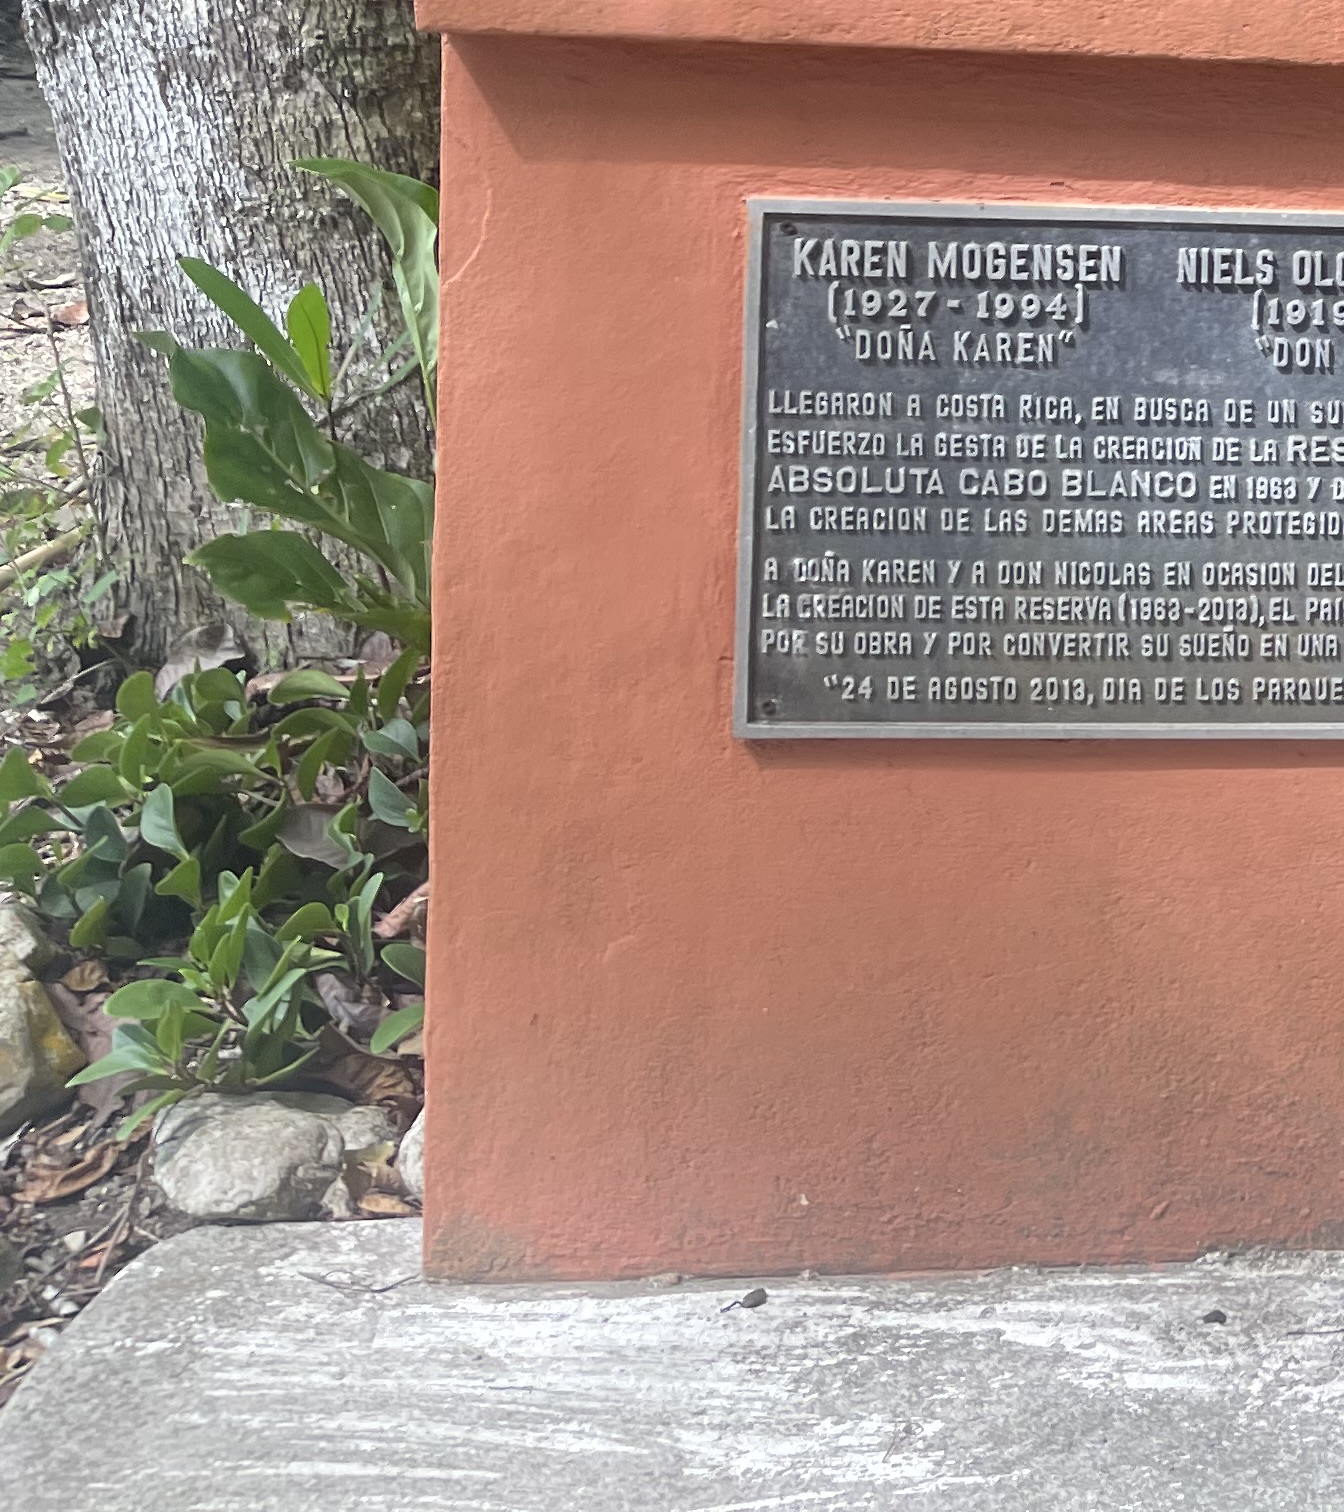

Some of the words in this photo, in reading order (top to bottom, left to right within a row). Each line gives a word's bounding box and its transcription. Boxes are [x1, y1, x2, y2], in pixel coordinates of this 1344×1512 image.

[793, 238, 908, 278] KAREN
[928, 241, 1122, 282] MOGENSEN
[1177, 247, 1275, 285] NIELS
[768, 389, 893, 416] LLEGARON
[907, 394, 921, 417] A
[936, 394, 1005, 418] COSTA
[1019, 394, 1083, 424] RICA,
[1091, 396, 1119, 421] EN
[1134, 397, 1209, 422] BUSCA
[1224, 399, 1253, 423] DE
[1267, 399, 1296, 423] UN
[767, 429, 885, 455] ESFUERZO
[897, 433, 923, 456] LA
[935, 432, 1005, 457] GESTA
[1016, 434, 1047, 459] DE
[1055, 434, 1082, 459] LA
[1093, 435, 1202, 461] CREACION
[1212, 437, 1240, 462] DE
[1249, 438, 1277, 462] LA
[768, 465, 944, 494] ABSOLUTA
[959, 467, 1047, 497] CABO
[1062, 468, 1197, 498] BLANCO
[1209, 474, 1237, 499] EN
[1246, 476, 1297, 500] 1963
[1307, 476, 1321, 500] Y
[765, 505, 796, 530] LA
[809, 506, 927, 531] CREACION
[941, 507, 970, 531] DE
[984, 508, 1028, 532] LAS
[1042, 508, 1123, 533] DEMAS
[1137, 509, 1214, 534] AREAS
[764, 557, 778, 581] A
[793, 549, 850, 583] DOÑA
[862, 559, 935, 583] KAREN
[947, 559, 963, 583] Y
[972, 560, 985, 584] A
[998, 560, 1042, 585] DON
[1054, 560, 1151, 586] NICOLAS
[1164, 561, 1191, 586] EN
[1202, 562, 1295, 586] OCASION
[761, 593, 790, 618] LA
[797, 593, 904, 619] CREACION
[914, 595, 942, 619] DE
[951, 595, 1004, 620] ESTA
[1014, 595, 1111, 620] RESERVA
[1269, 597, 1296, 621] EL
[761, 629, 806, 655] POR
[815, 631, 844, 655] SU
[854, 631, 911, 655] OBRA
[923, 631, 938, 655] Y
[948, 631, 991, 656] POR
[1003, 631, 1129, 656] CONVERTIR
[1141, 633, 1170, 656] SU
[1179, 625, 1249, 657] SUEÑO
[1259, 633, 1288, 656] EN
[1297, 634, 1338, 657] UNA
[887, 675, 917, 700] DE
[928, 676, 1017, 701] AGOSTO
[1030, 676, 1094, 705] 2013,
[1103, 677, 1141, 701] DIA
[1154, 677, 1185, 701] DE
[1195, 677, 1240, 701] LOS
